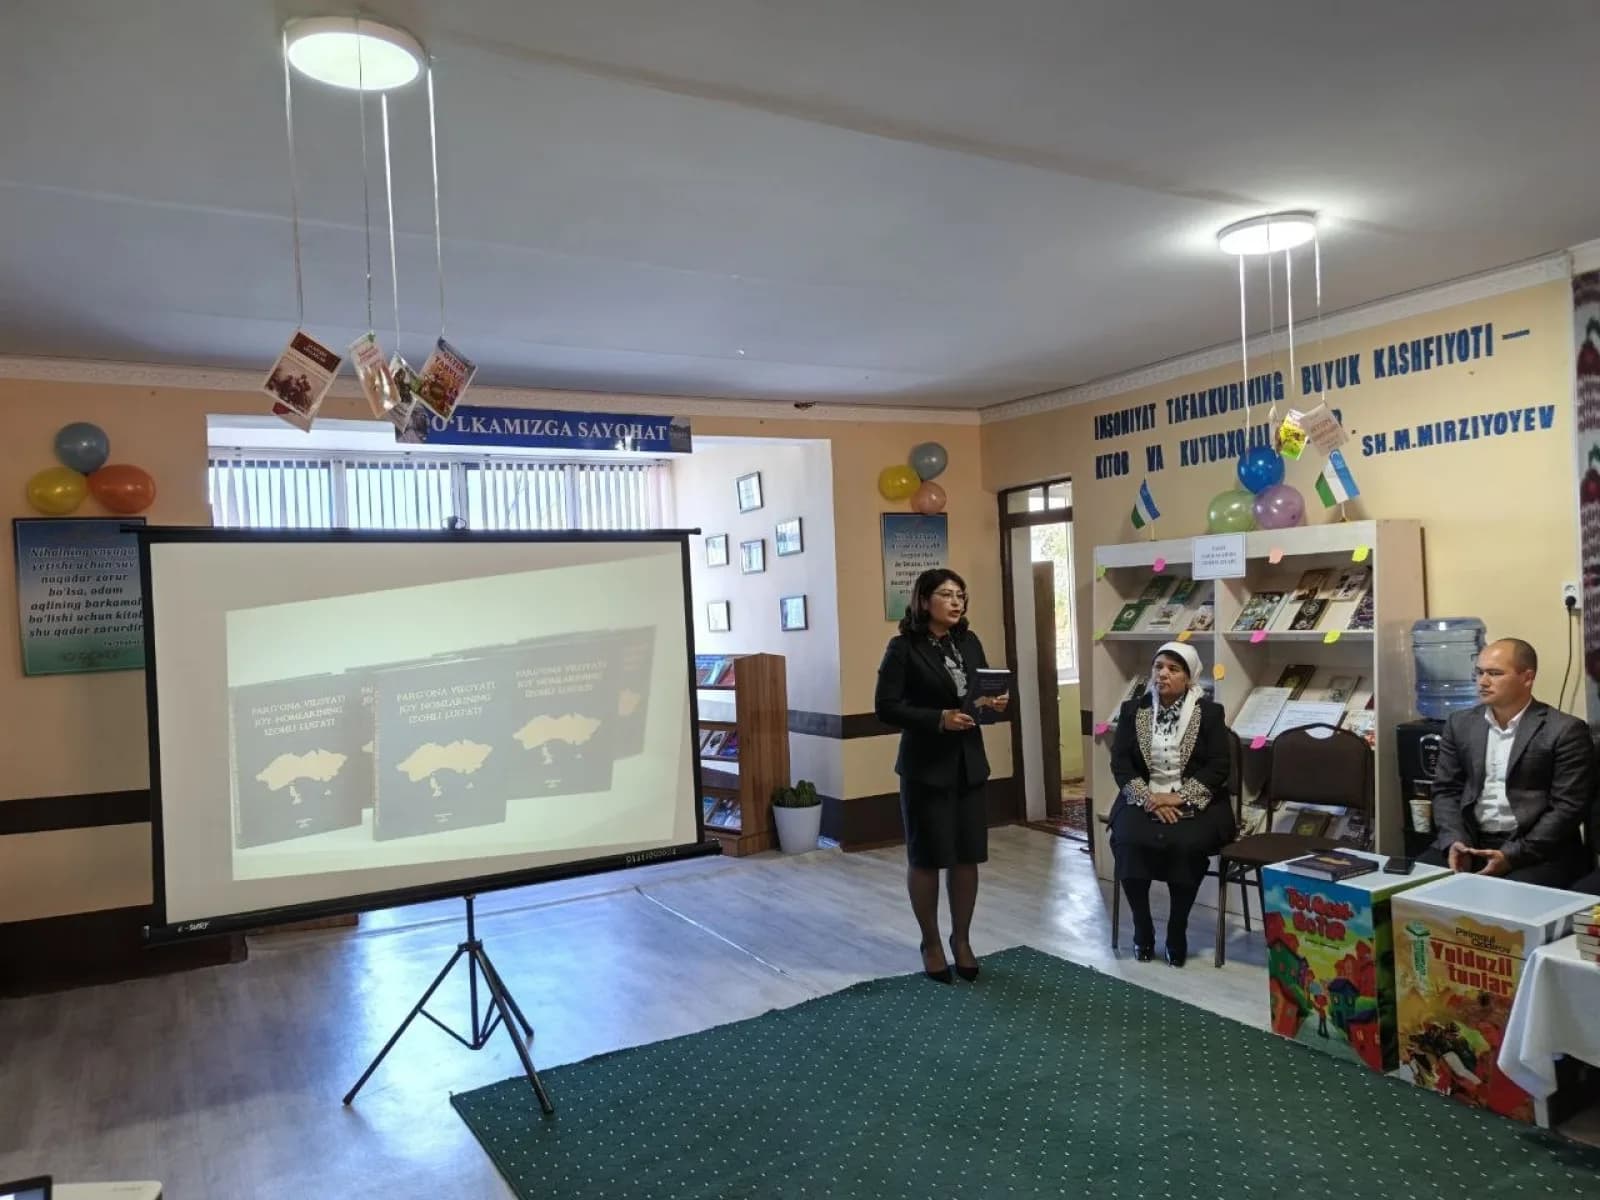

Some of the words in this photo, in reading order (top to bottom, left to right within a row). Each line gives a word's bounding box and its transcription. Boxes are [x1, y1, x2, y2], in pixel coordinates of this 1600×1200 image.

[1094, 403, 1156, 440] INSONIYAT
[1166, 371, 1285, 424] TAFAKKURINING
[1301, 354, 1361, 395] BUYUK
[1373, 323, 1493, 379] KASHFIYOTI
[578, 421, 667, 441] SAYOHAT
[1096, 451, 1129, 480] KITOB
[1146, 445, 1164, 472] VA
[76, 560, 112, 570] uchun
[96, 574, 128, 582] zarur
[76, 611, 112, 621] uchun
[29, 627, 50, 638] shu
[54, 626, 90, 638] qadar
[1430, 940, 1513, 977] Yulduzli
[1447, 963, 1513, 995] tunlar
